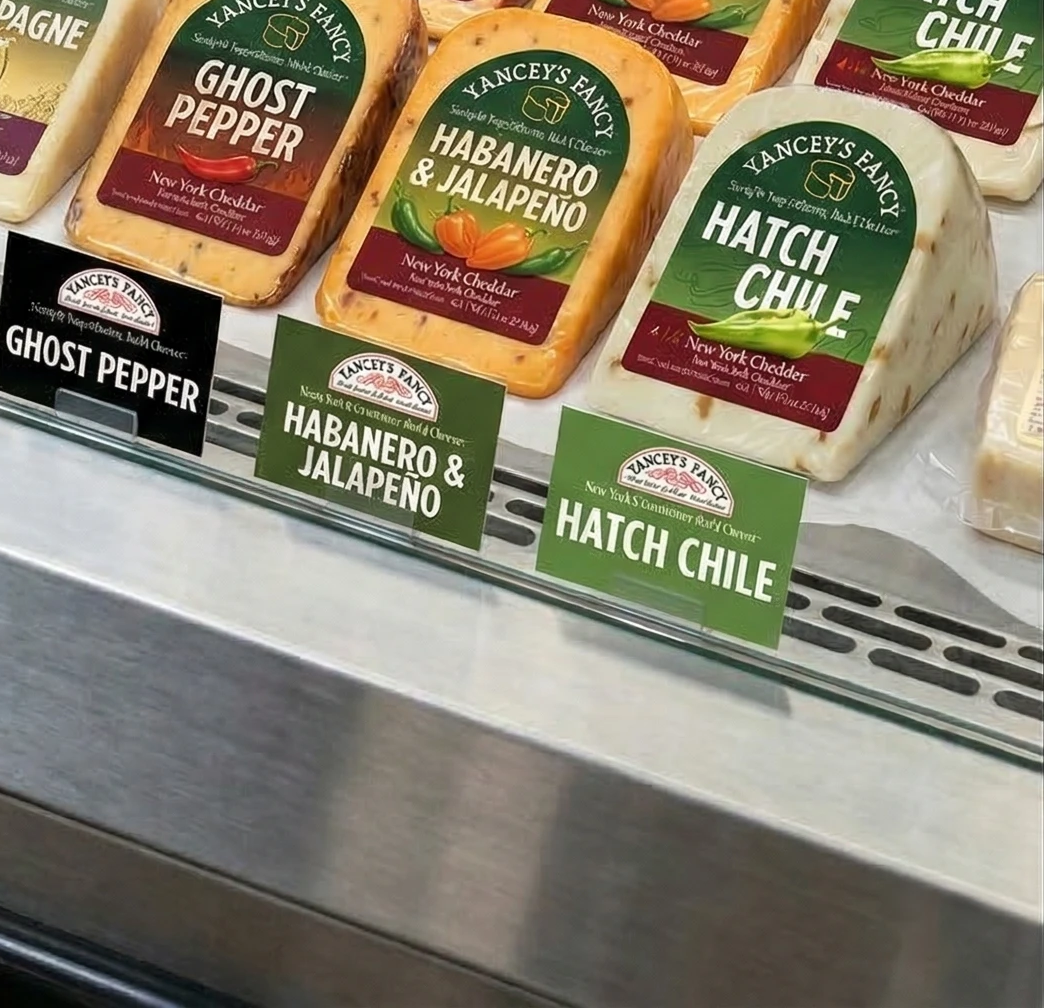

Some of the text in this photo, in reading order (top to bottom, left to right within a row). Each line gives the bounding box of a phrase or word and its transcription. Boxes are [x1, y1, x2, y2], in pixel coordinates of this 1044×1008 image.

[916, 11, 1035, 74] CHILE
[194, 60, 316, 119] GHOST
[462, 63, 571, 100] YANCEY'S
[570, 75, 613, 139] FANCY
[900, 74, 929, 93] York
[931, 82, 986, 108] Cheddar
[164, 93, 304, 162] PEPPER
[429, 123, 598, 198] HABANERO
[743, 135, 855, 175] YANCEY'S
[148, 170, 177, 188] New
[179, 178, 208, 196] York
[409, 158, 587, 232] & JALAPEÑO
[701, 201, 839, 276] HATCH
[401, 254, 519, 299] New York Cheddar
[733, 263, 861, 339] CHILE
[6, 325, 92, 377] GHOST
[97, 352, 199, 413] PEPPER
[685, 336, 716, 358] New
[719, 344, 748, 366] York
[283, 401, 438, 478] HABANERO
[443, 454, 465, 488] &
[298, 445, 440, 518] JALAPEÑO
[556, 498, 669, 569] HATCH
[677, 538, 776, 603] CHILE
